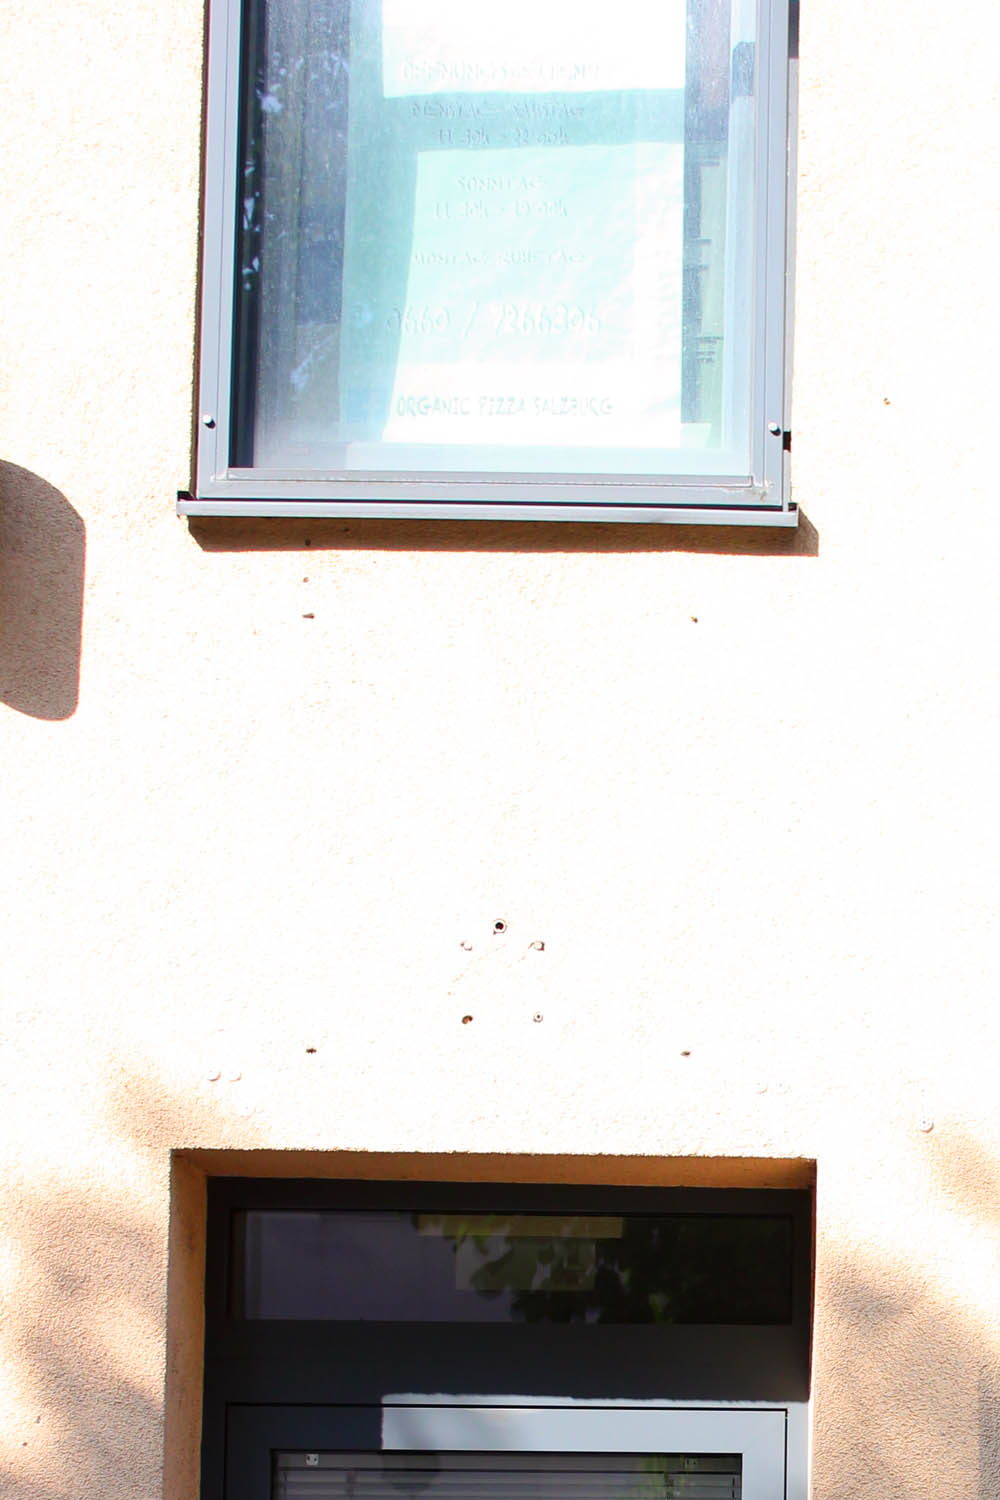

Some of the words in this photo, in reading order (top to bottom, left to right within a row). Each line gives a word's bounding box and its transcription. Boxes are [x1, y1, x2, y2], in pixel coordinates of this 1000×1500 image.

[396, 397, 471, 416] ORGANIC
[478, 397, 526, 416] PIZZA
[534, 397, 614, 416] SALZBURG
